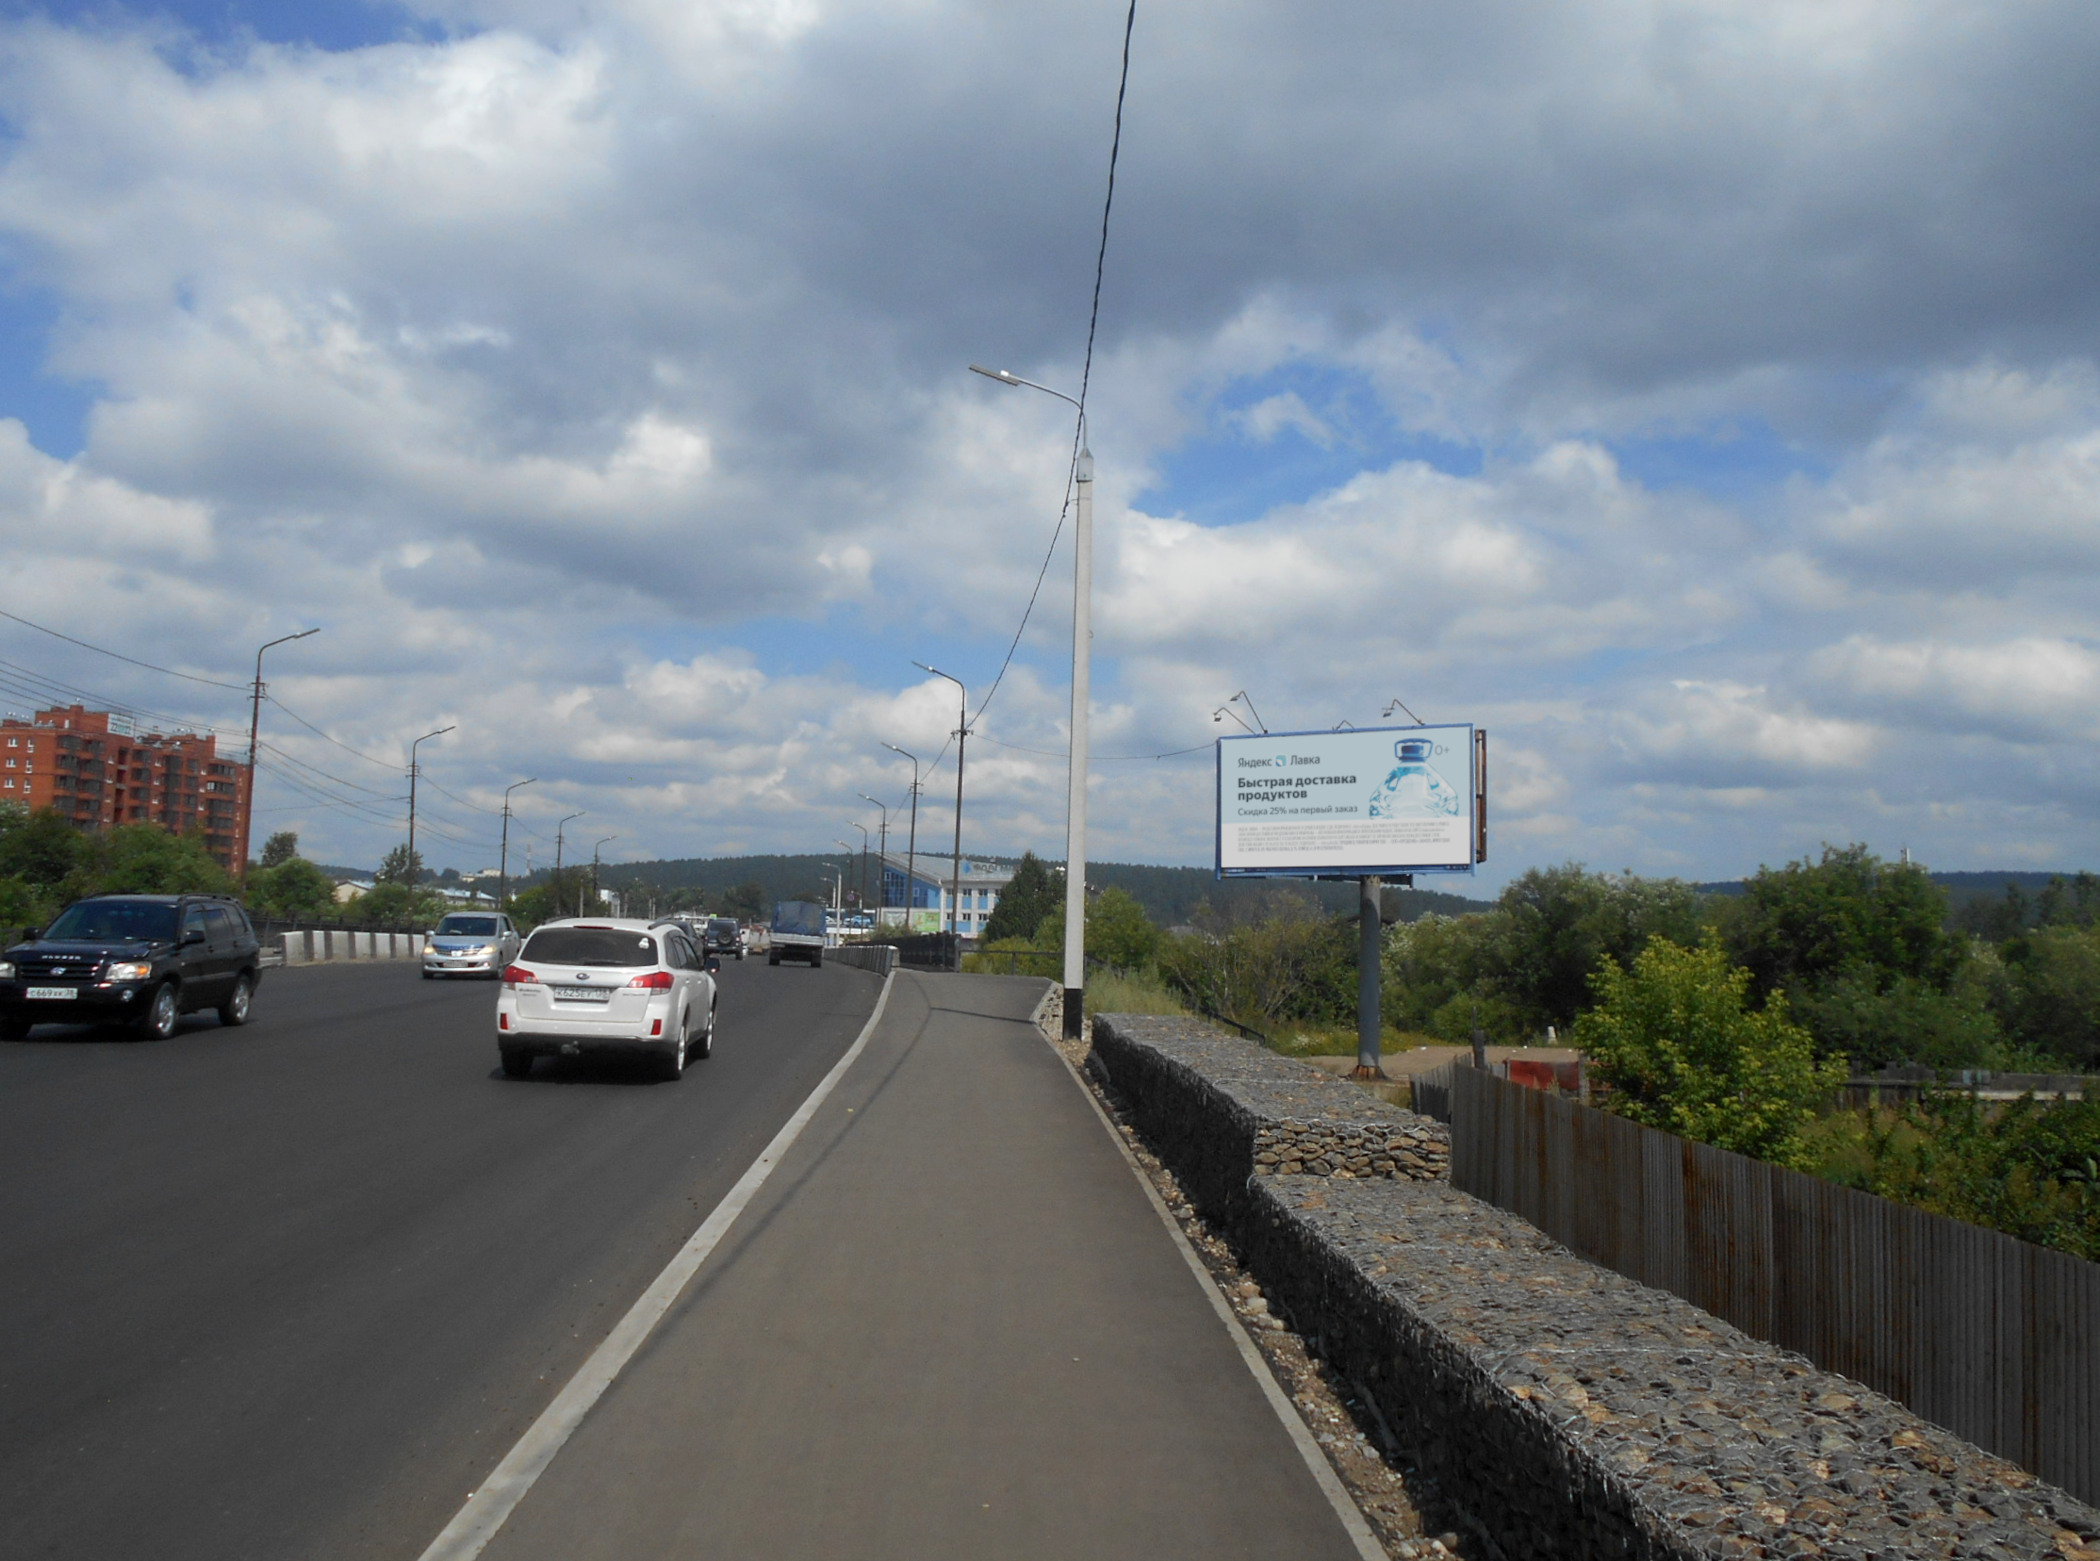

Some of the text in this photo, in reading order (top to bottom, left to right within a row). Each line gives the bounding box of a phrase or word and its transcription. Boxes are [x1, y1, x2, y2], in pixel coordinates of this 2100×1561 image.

[1434, 744, 1450, 756] 0+
[1238, 755, 1321, 769] Яндекс Лавка
[1238, 775, 1357, 789] Быстрая доставка
[1238, 790, 1308, 803] продуктов
[1238, 807, 1268, 817] Скидка
[1269, 806, 1287, 816] 25%
[1300, 805, 1333, 816] первый
[1334, 805, 1358, 813] заказ
